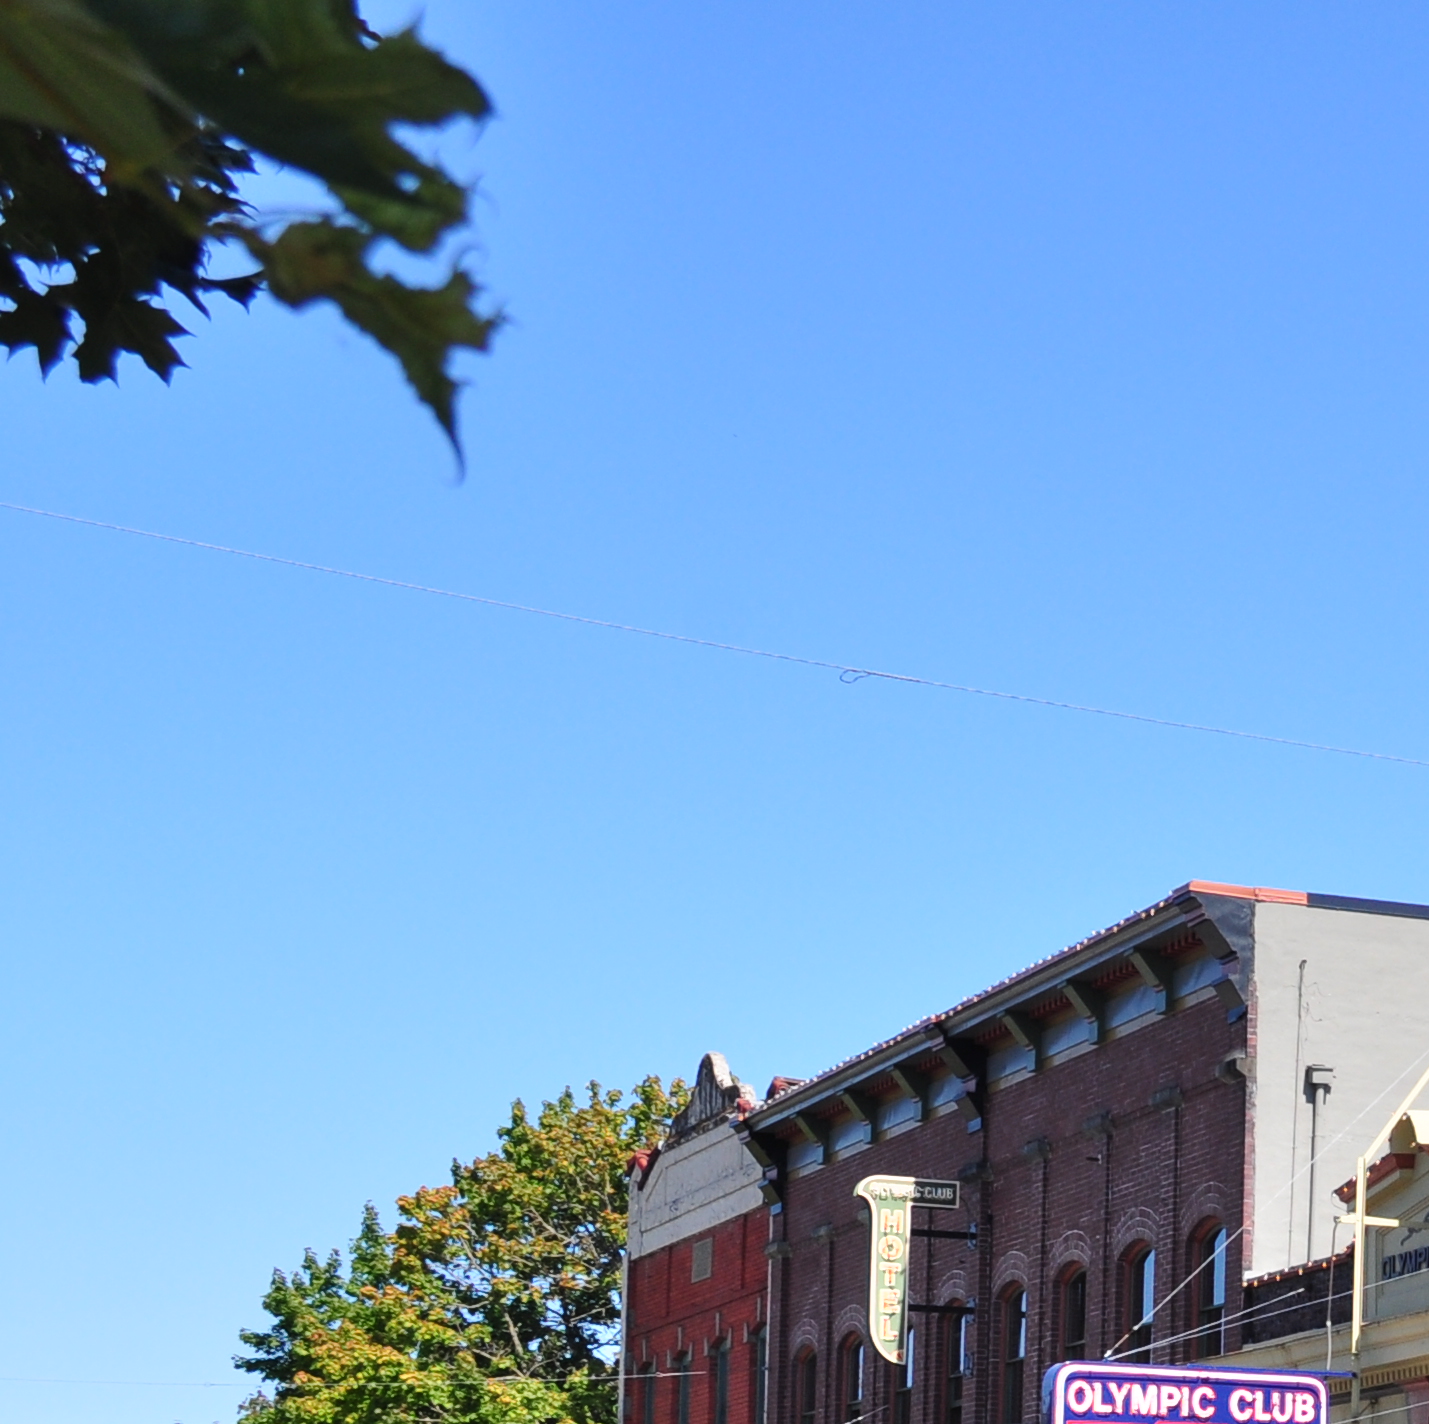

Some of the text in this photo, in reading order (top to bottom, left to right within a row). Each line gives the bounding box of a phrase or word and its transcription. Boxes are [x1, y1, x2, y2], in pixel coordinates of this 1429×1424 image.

[925, 1186, 953, 1199] CLUB
[878, 1208, 904, 1342] HOTEL
[1067, 1378, 1317, 1424] OLYMPIC CLUB
